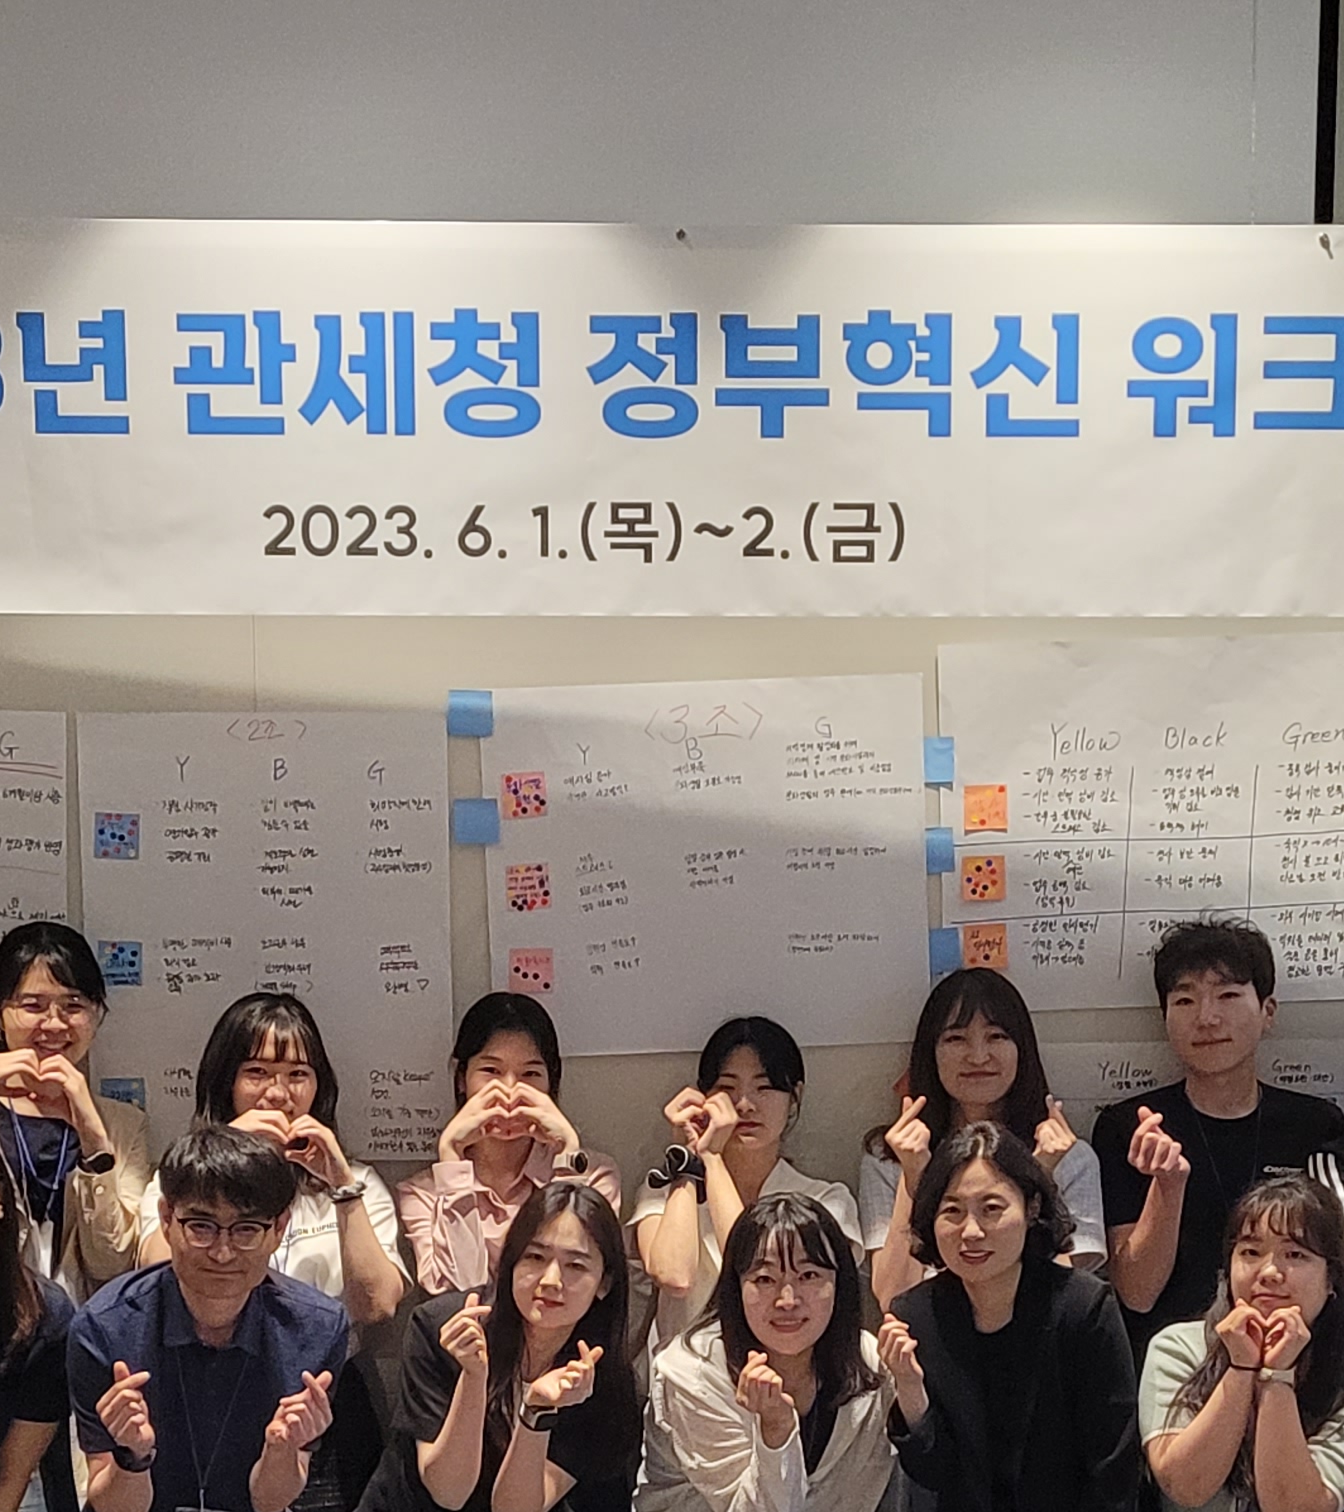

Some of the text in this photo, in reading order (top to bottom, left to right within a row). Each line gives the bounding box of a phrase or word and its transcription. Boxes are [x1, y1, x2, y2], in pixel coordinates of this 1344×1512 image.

[172, 307, 543, 440] 관세청
[584, 307, 1082, 440] 정부혁신
[260, 501, 436, 560] 2023.
[456, 501, 511, 560] 6.
[575, 716, 833, 766] Y B G
[1050, 721, 1121, 760] Yellow
[1164, 721, 1229, 749] Black
[175, 755, 191, 782] Y
[272, 757, 288, 781] B
[1098, 1058, 1312, 1081] Yellow Green
